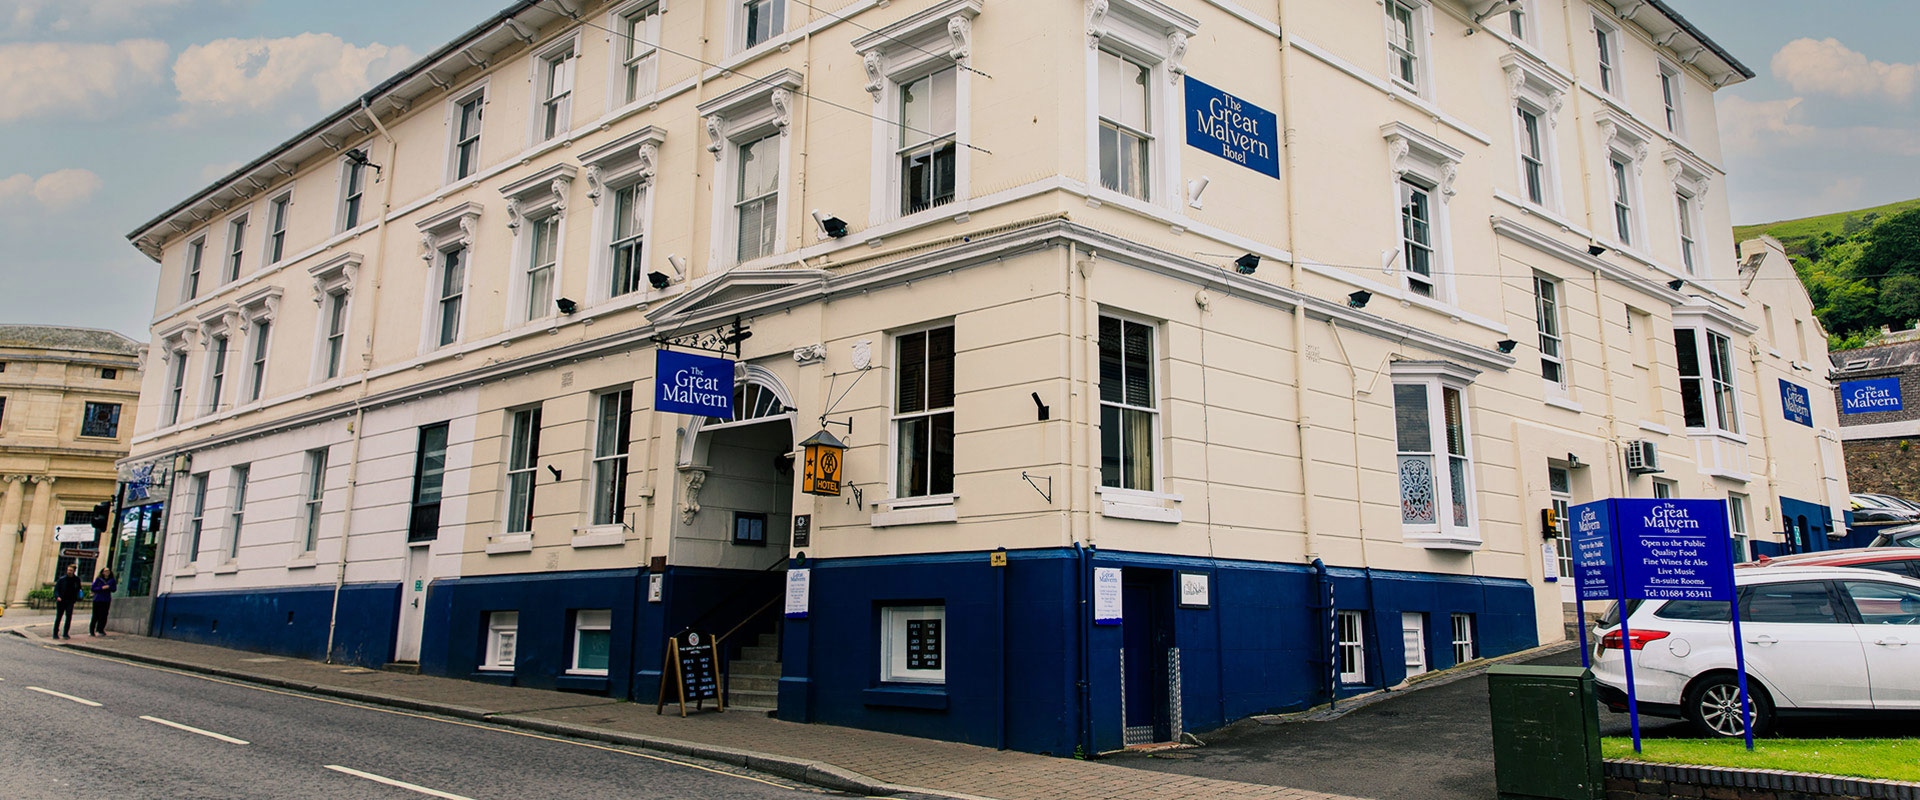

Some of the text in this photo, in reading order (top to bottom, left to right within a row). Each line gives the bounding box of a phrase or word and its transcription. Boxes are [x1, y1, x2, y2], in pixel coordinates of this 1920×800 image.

[1223, 93, 1242, 112] The
[1210, 97, 1259, 136] Great
[1196, 109, 1269, 160] Malvern
[1222, 143, 1247, 164] Hotel
[690, 366, 704, 376] The
[675, 369, 719, 391] Great
[662, 383, 728, 408] Malvern
[1786, 387, 1805, 405] Great
[1854, 388, 1890, 400] Great
[1784, 397, 1809, 417] Malvern
[1846, 397, 1899, 409] Malvern
[817, 480, 838, 492] HOTEL
[1580, 510, 1596, 522] Great
[1652, 506, 1689, 518] Great
[1578, 521, 1601, 532] Malvern
[1643, 516, 1700, 528] Malvern
[1641, 540, 1660, 548] Open
[1652, 549, 1678, 558] Quality
